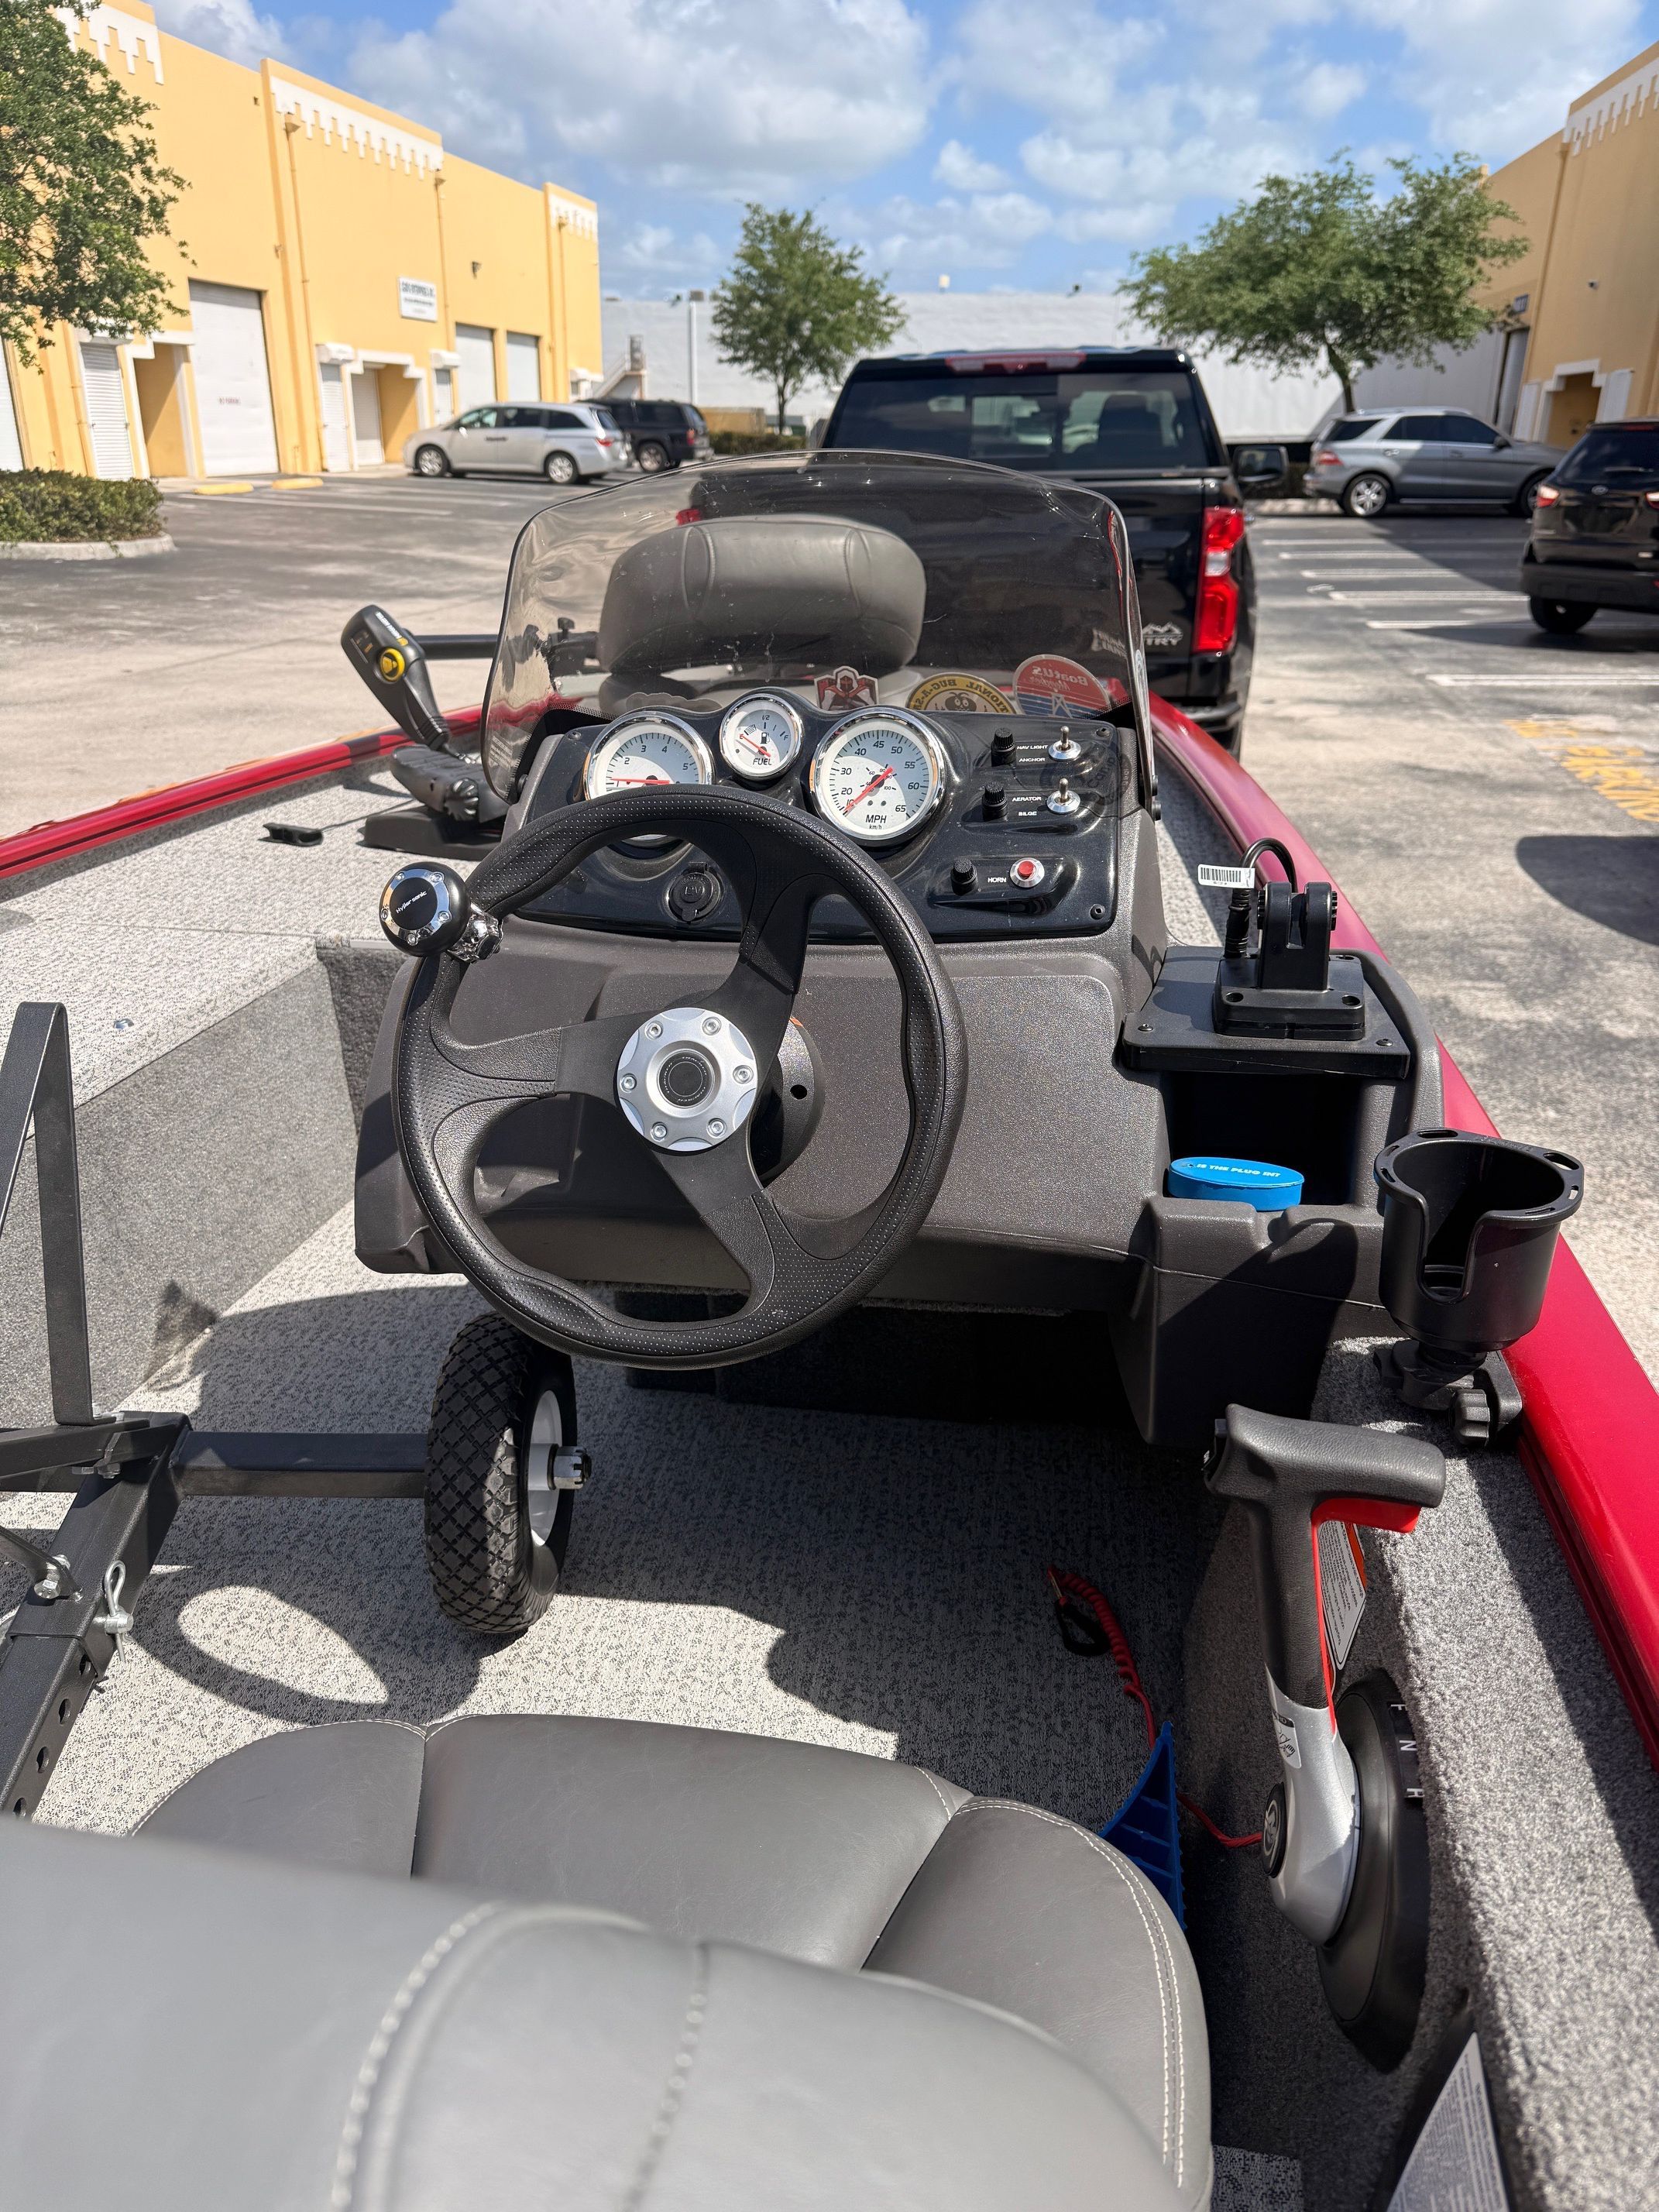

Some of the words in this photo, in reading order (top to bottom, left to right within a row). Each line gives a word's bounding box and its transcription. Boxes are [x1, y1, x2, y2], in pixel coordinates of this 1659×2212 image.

[641, 744, 647, 753] 3
[854, 747, 867, 756] 40
[891, 746, 902, 754] 50
[904, 761, 915, 769] 55
[908, 781, 919, 790] 60
[841, 787, 853, 795] 20
[865, 815, 887, 823] MPH
[1399, 1740, 1418, 1751] N
